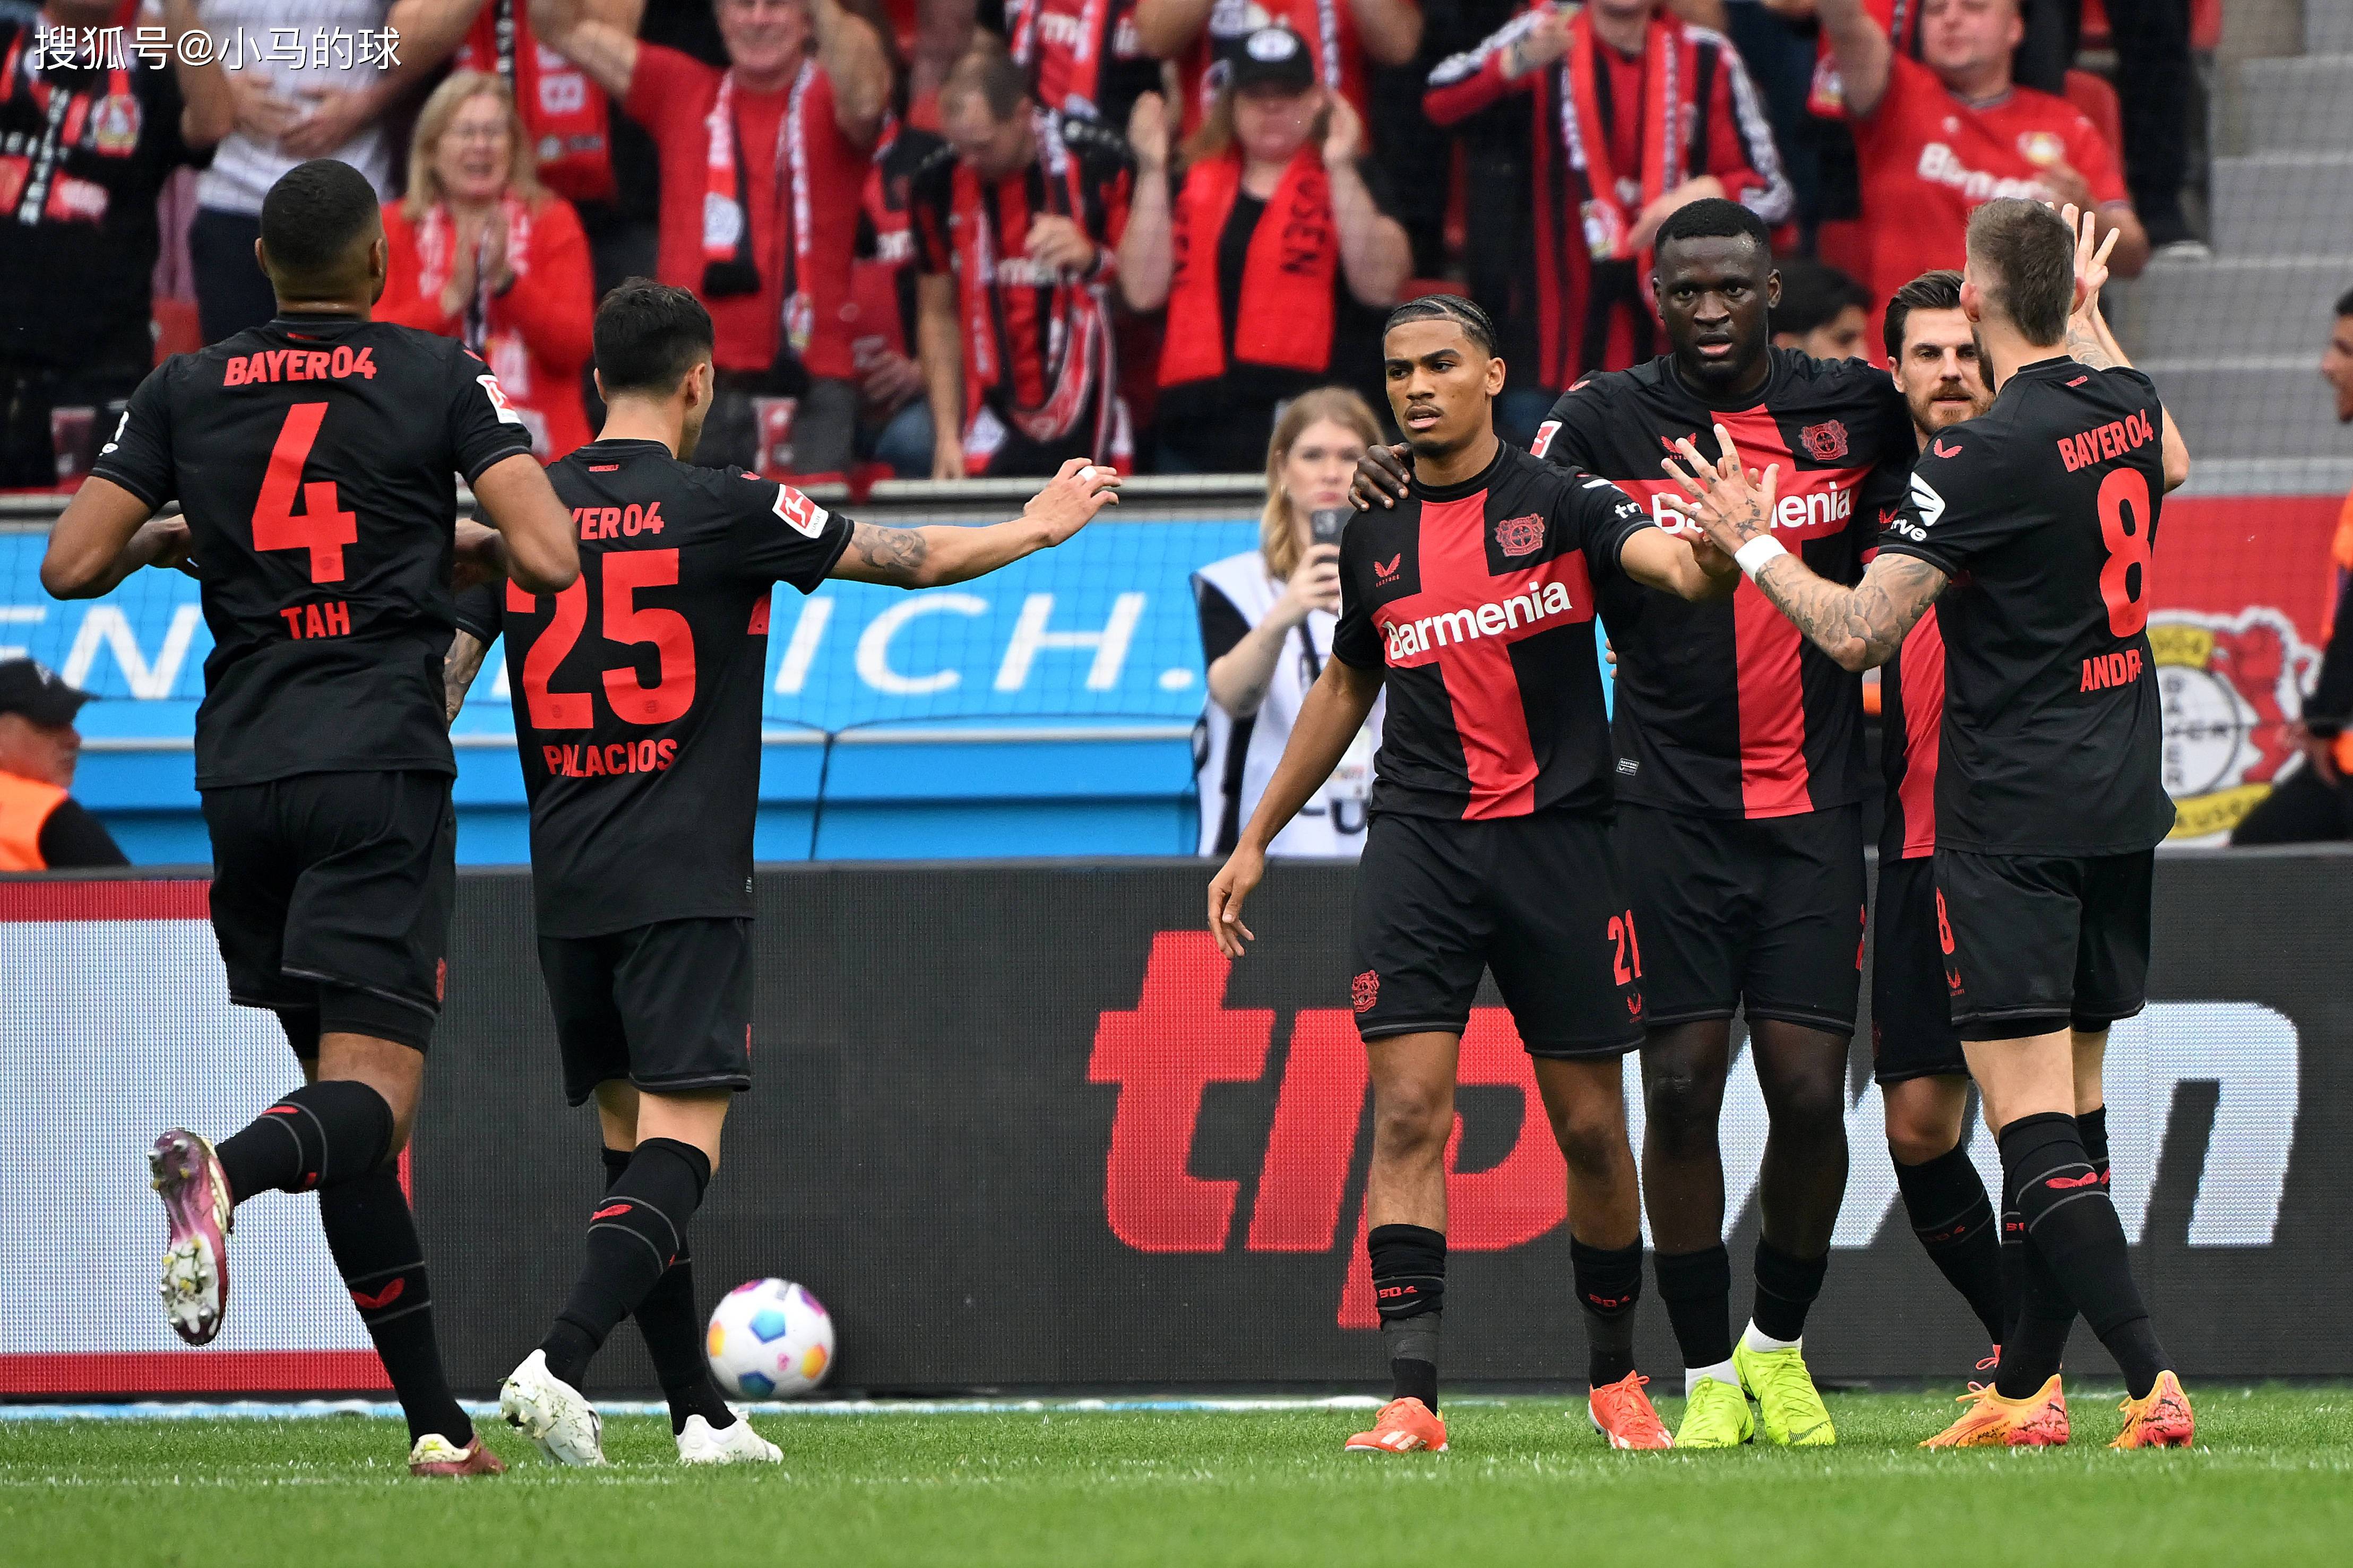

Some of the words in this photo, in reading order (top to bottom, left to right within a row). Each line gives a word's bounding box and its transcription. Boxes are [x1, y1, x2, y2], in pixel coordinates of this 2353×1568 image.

[252, 402, 358, 584] 4
[2097, 467, 2152, 638] 8
[280, 601, 350, 639] TAH
[506, 548, 696, 730] 25
[1382, 581, 1573, 660] Barmenia
[542, 739, 678, 777] PALACIOS
[1607, 909, 1642, 986] 21
[1936, 886, 1955, 955] 8
